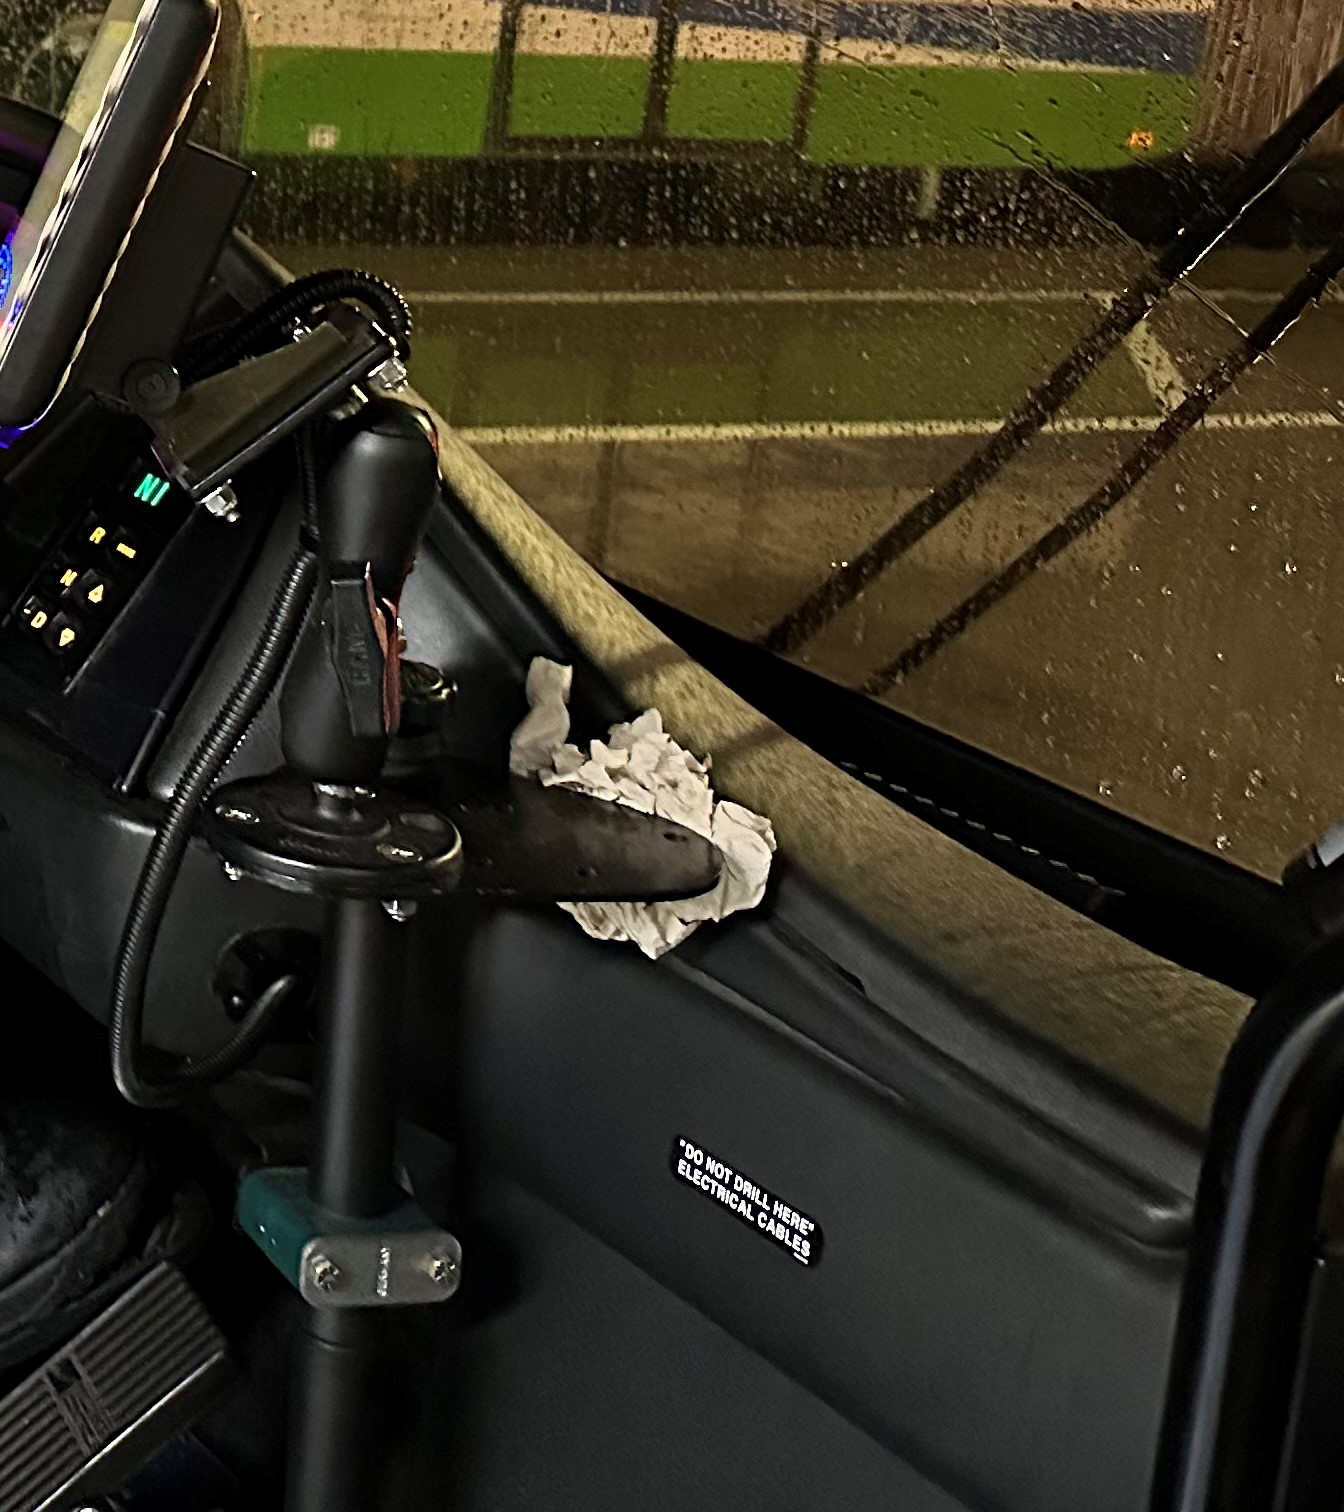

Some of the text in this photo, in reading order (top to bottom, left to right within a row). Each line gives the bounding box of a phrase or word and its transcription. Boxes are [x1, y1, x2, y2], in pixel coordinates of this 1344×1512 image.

[89, 526, 106, 544] R
[60, 568, 78, 587] N
[30, 610, 47, 628] D
[705, 1156, 733, 1184] NOT
[734, 1174, 770, 1211] DRILL
[677, 1158, 811, 1257] ELECTRICAL CABLES
